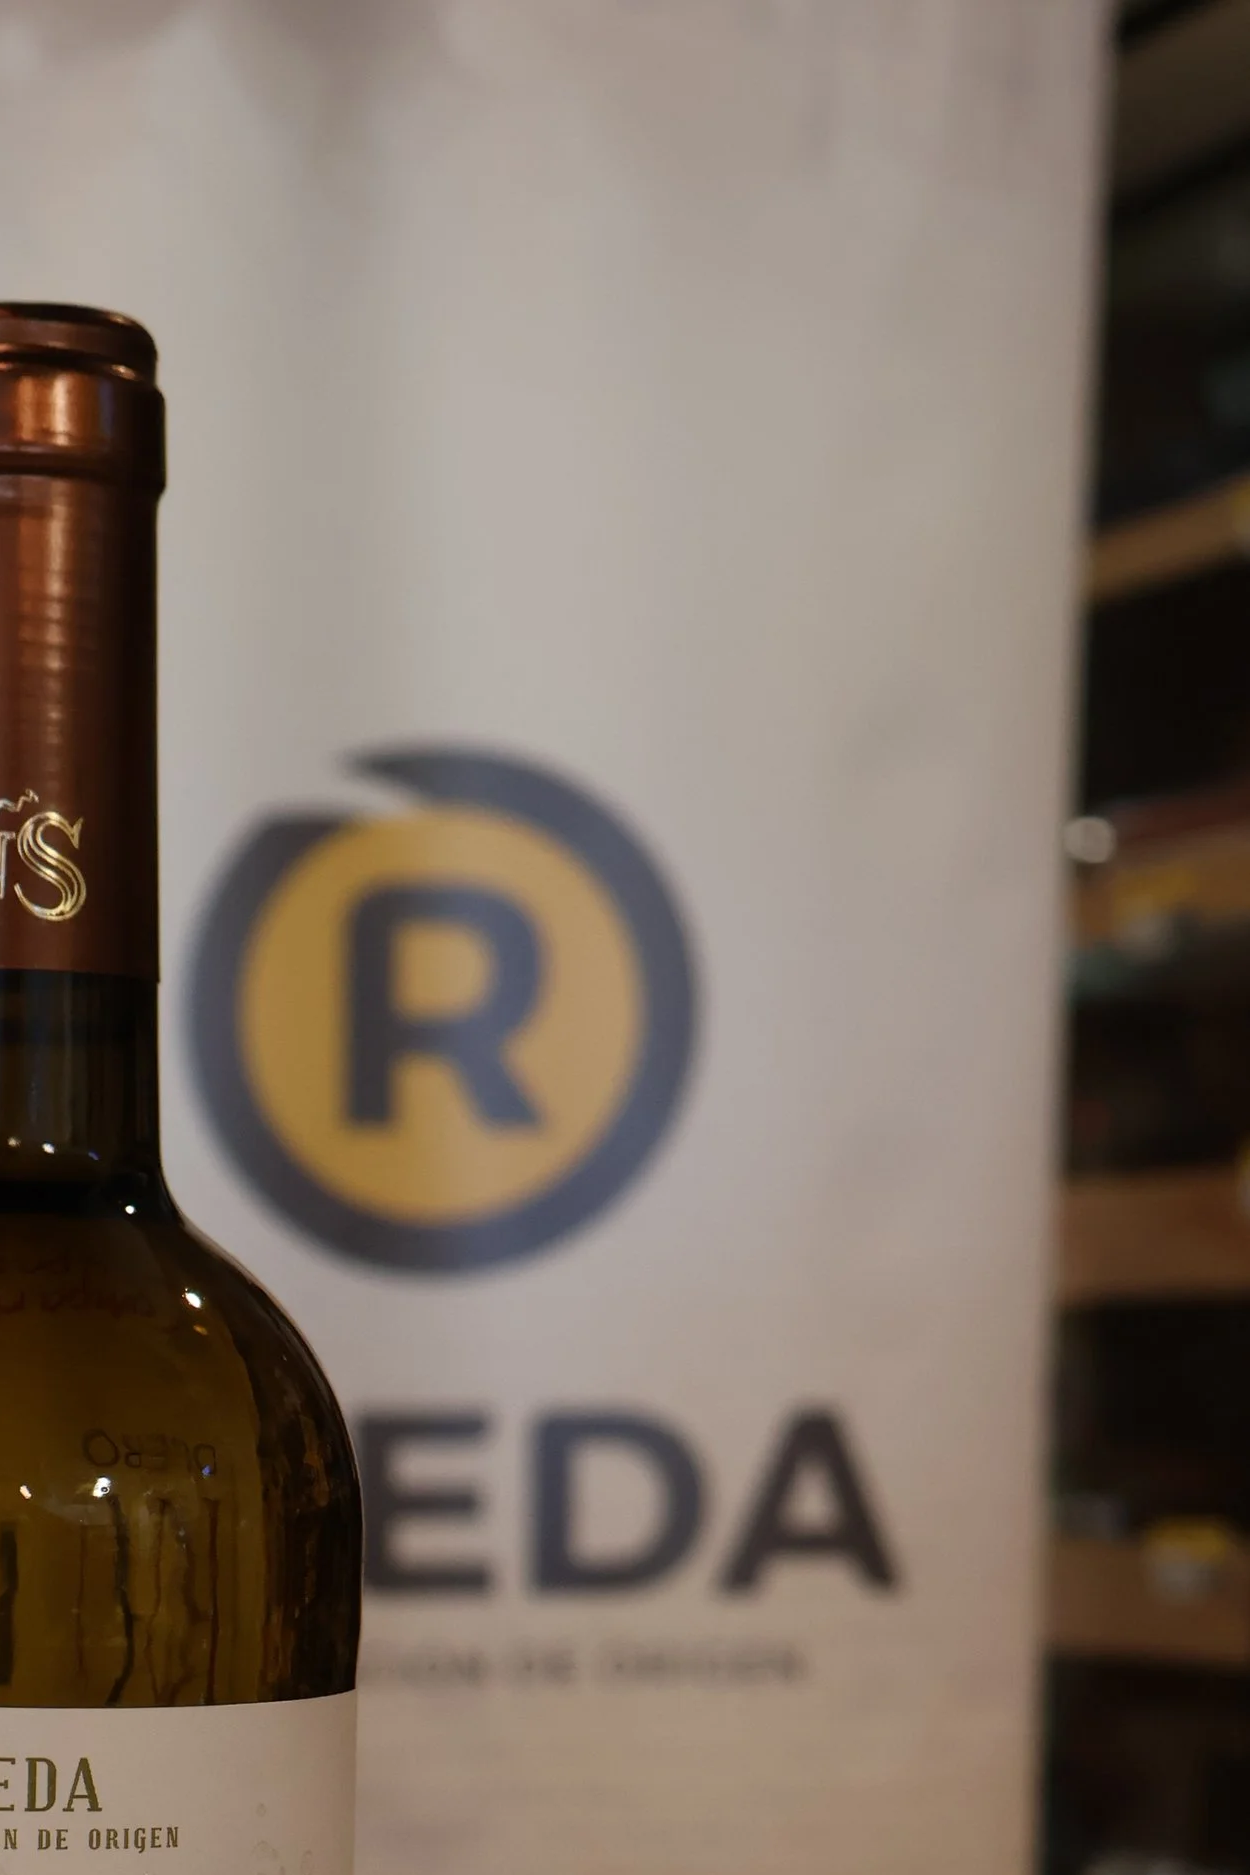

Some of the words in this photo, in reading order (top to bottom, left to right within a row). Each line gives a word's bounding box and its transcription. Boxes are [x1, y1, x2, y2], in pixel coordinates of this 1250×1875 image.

[334, 874, 545, 1137] R
[356, 1402, 908, 1601] EDA
[36, 1828, 69, 1851] DE
[88, 1825, 180, 1854] ORIGEN
